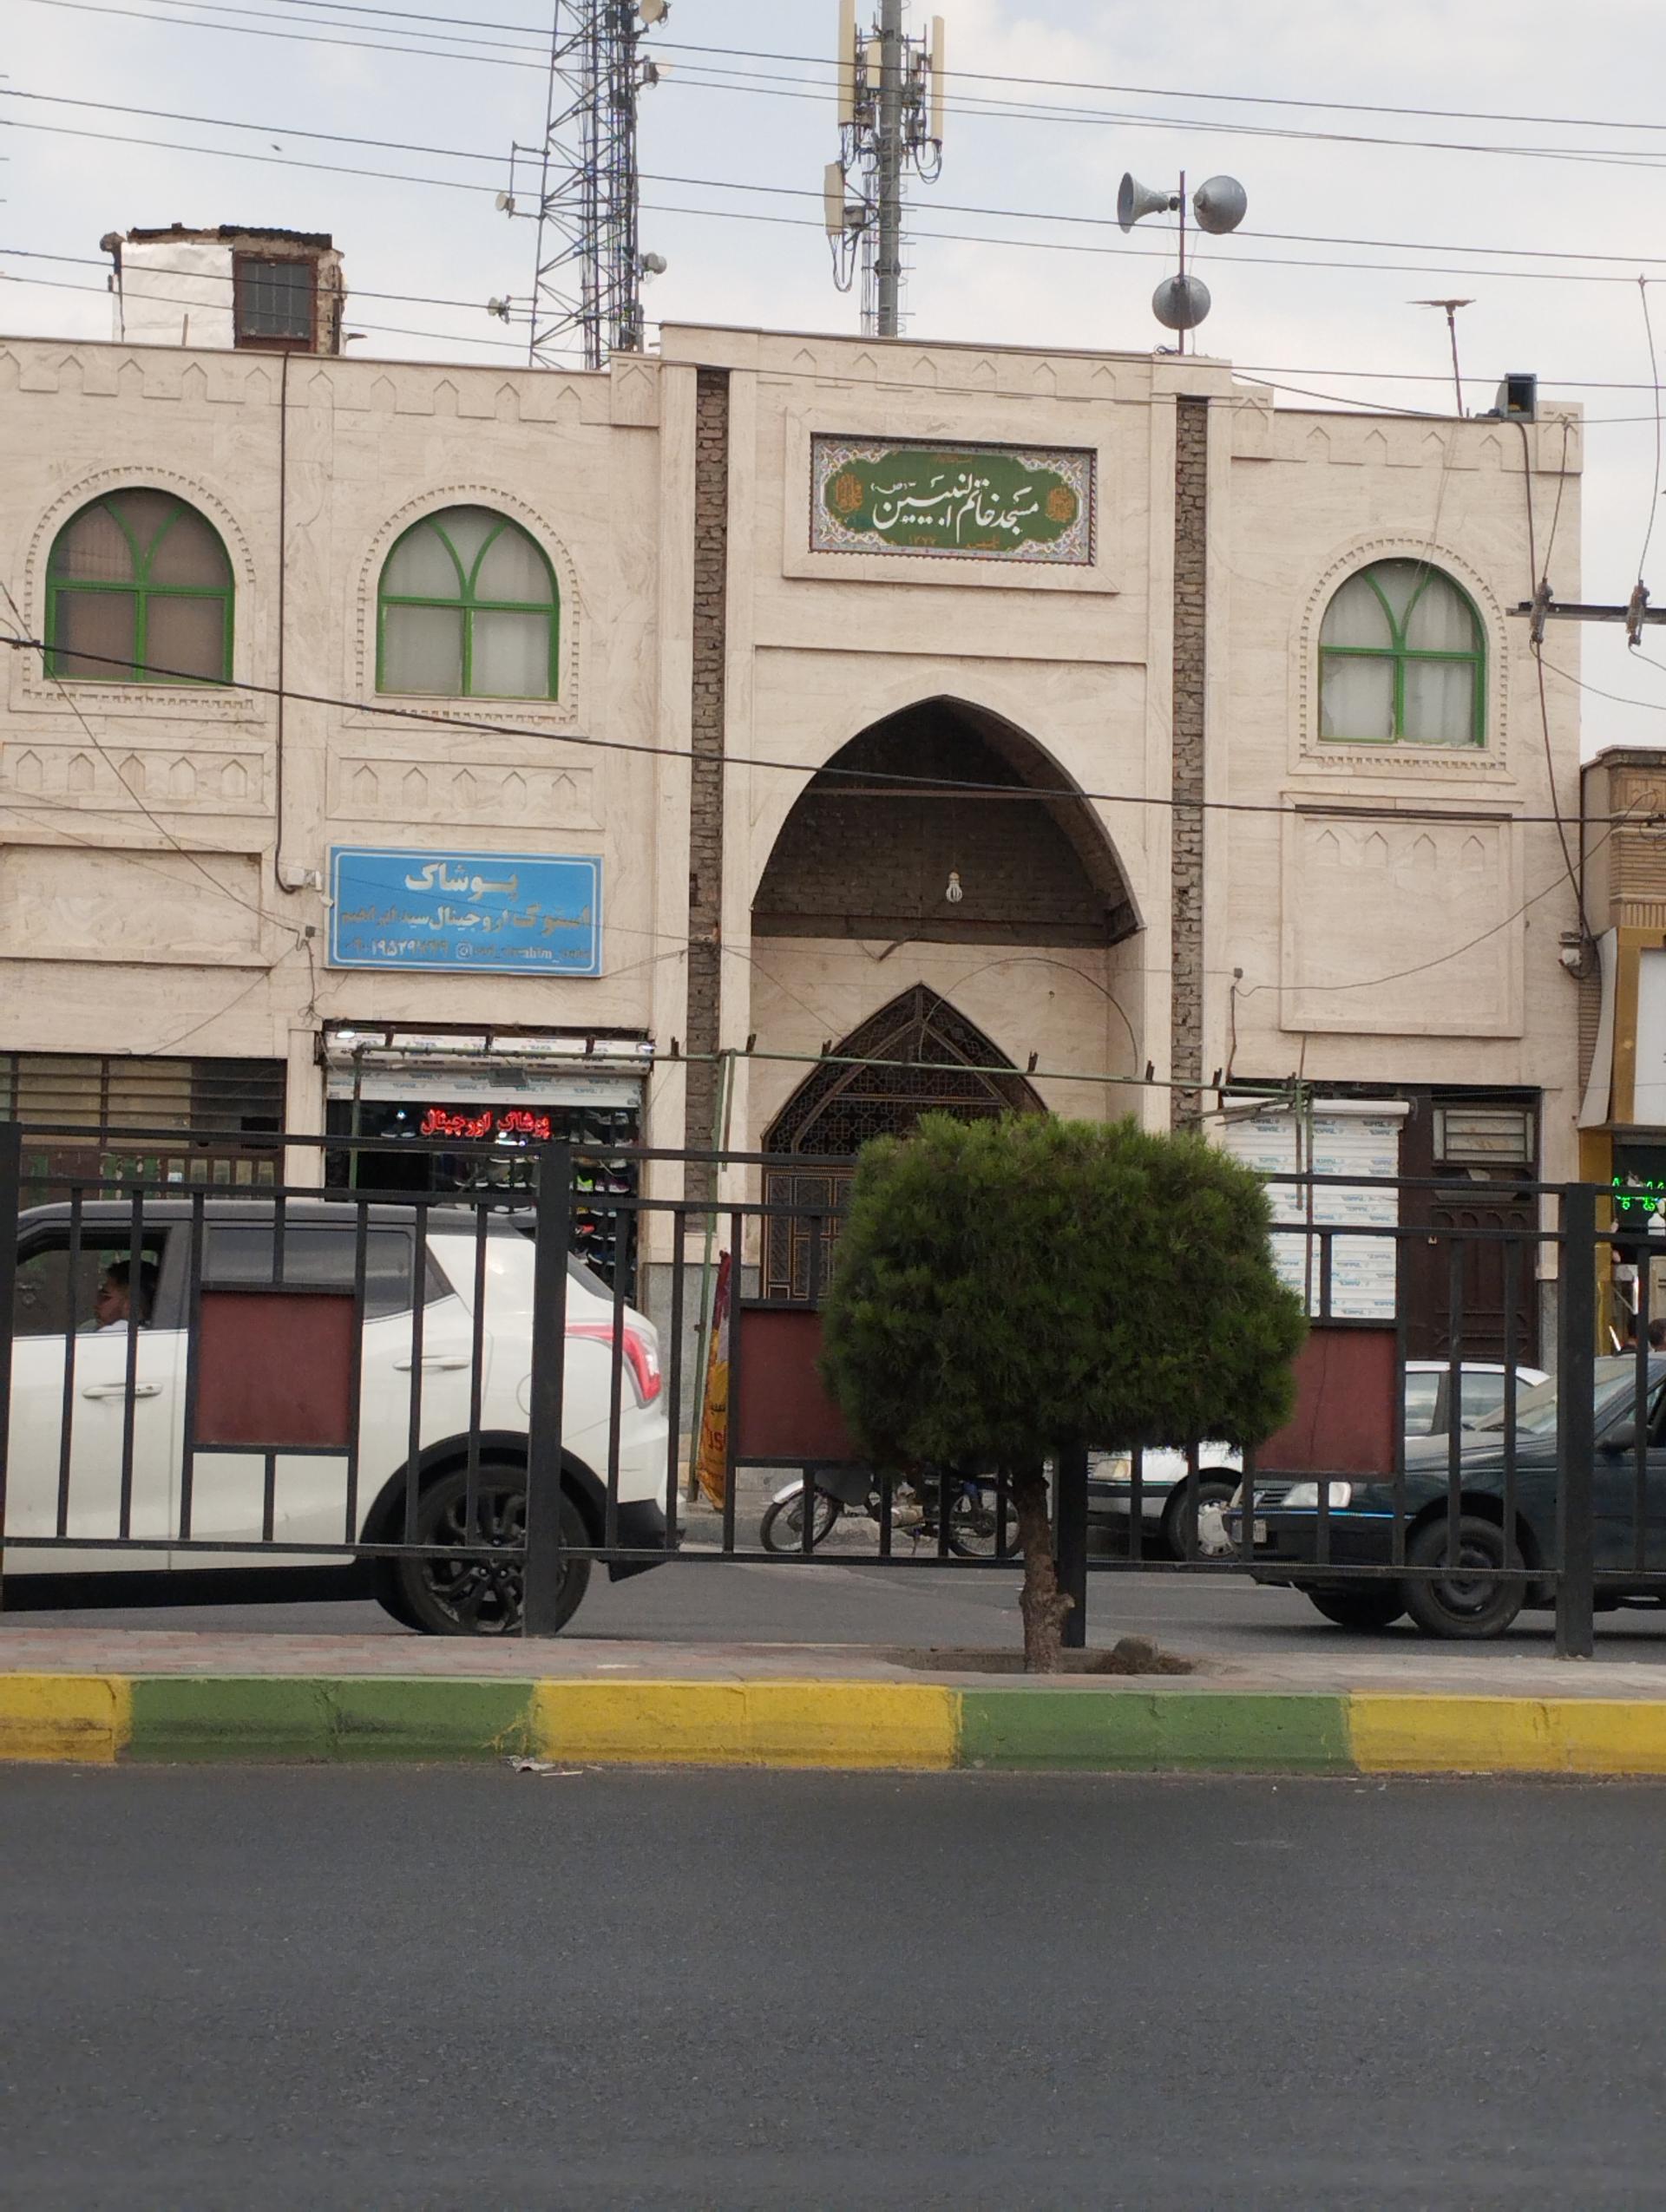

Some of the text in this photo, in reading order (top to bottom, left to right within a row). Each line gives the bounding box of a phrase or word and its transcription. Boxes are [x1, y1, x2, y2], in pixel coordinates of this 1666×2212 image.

[994, 485, 1040, 535] مسجد
[405, 861, 519, 902] پوشاک
[496, 1109, 552, 1140] پوشاک
